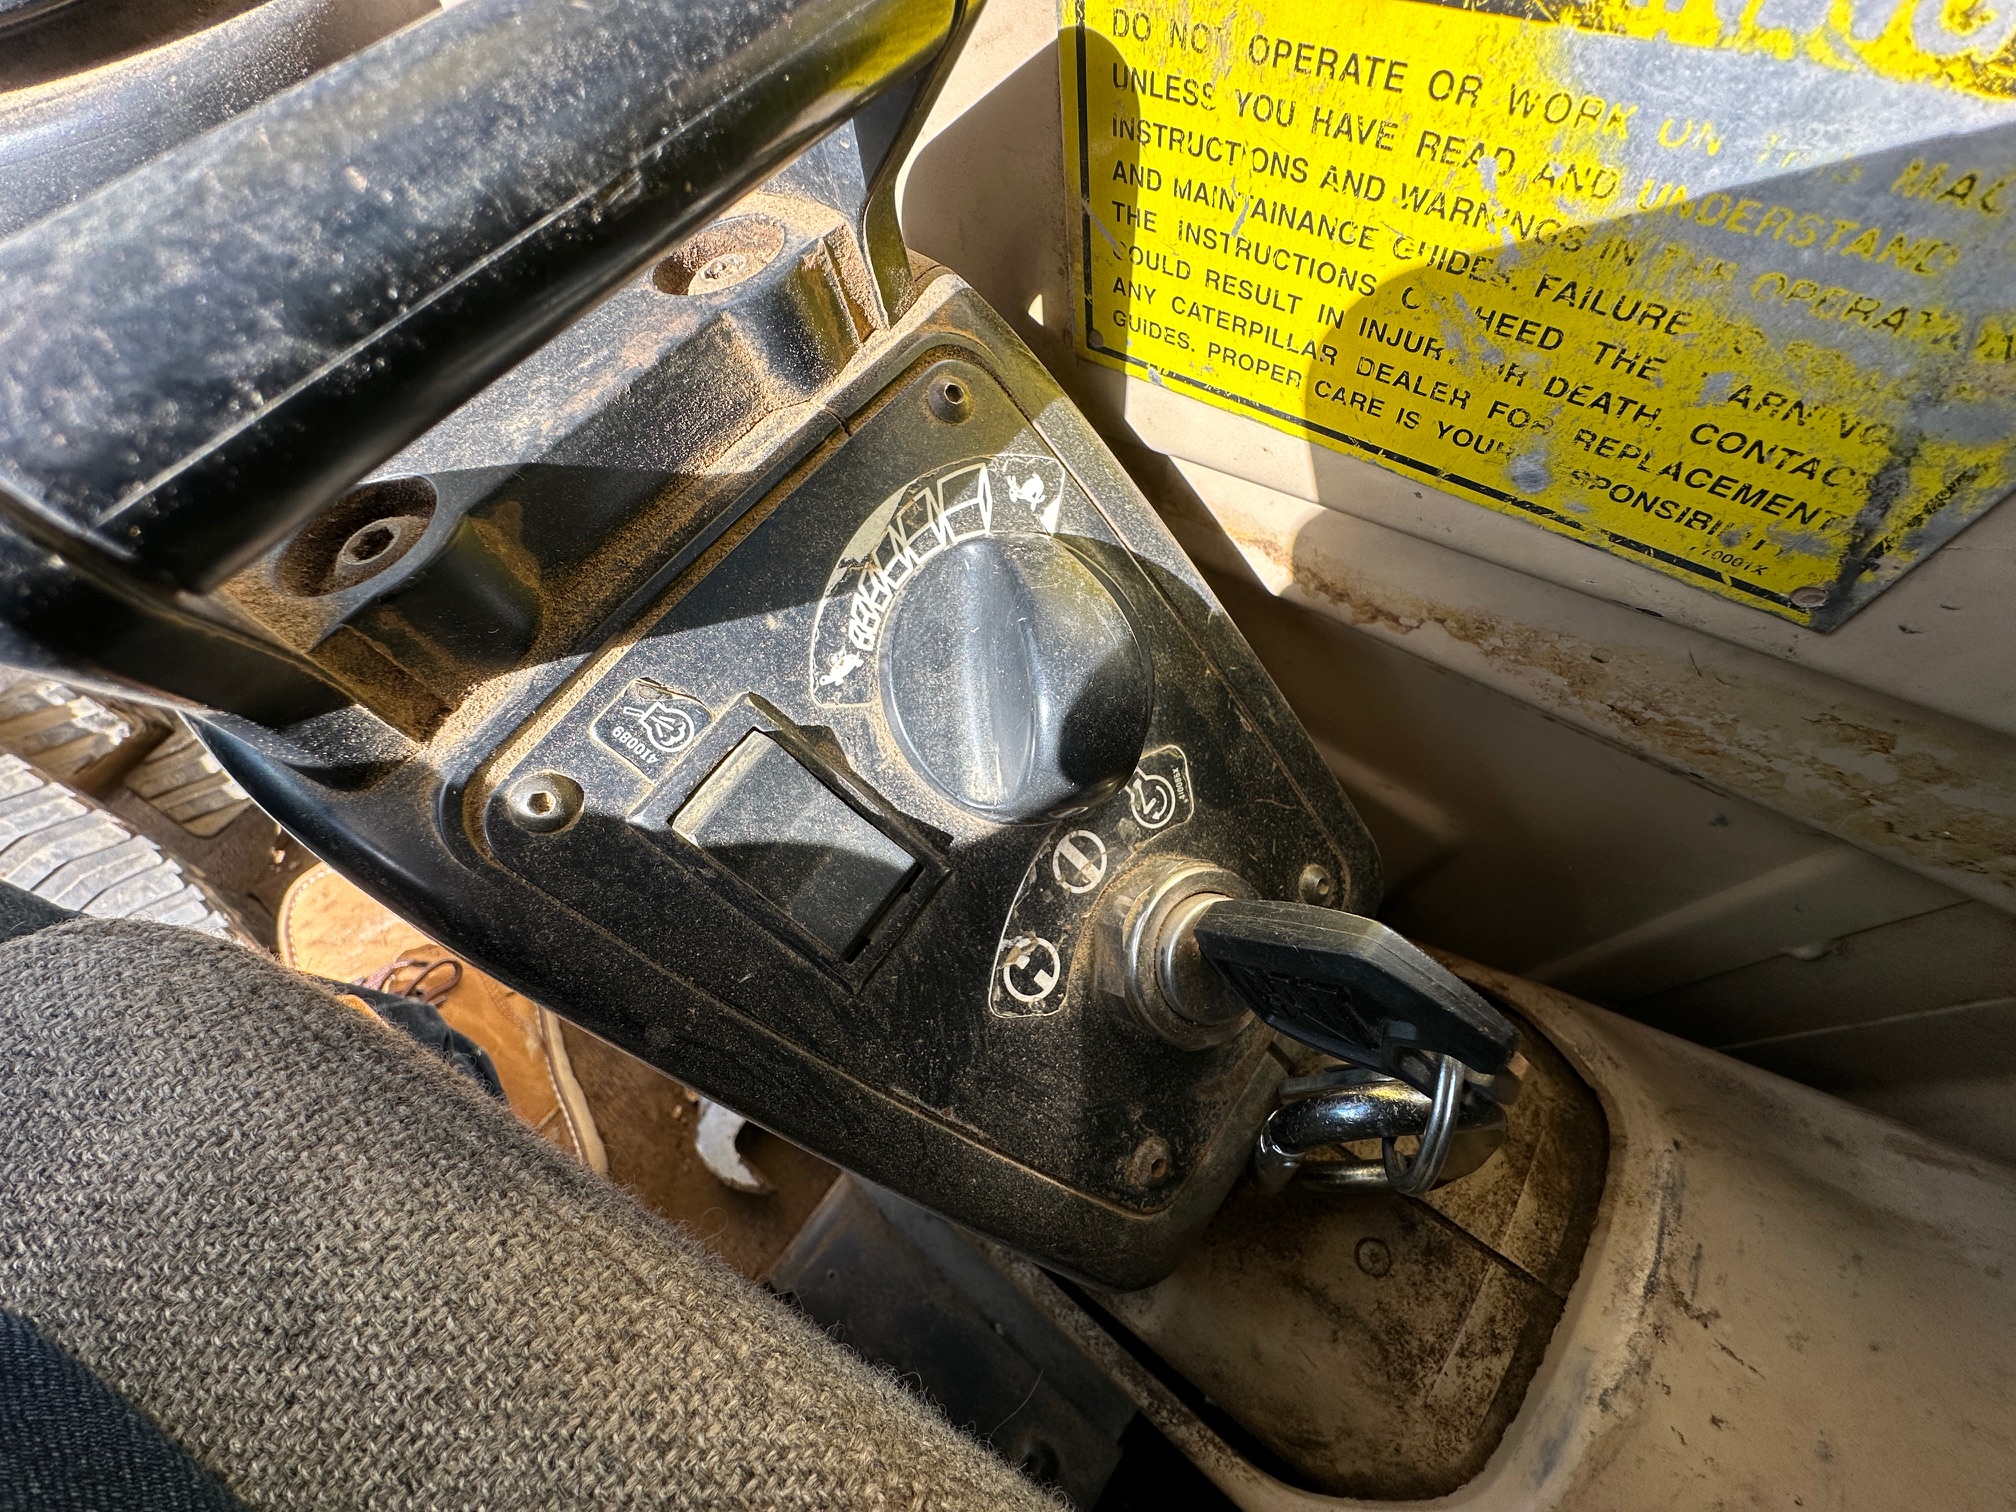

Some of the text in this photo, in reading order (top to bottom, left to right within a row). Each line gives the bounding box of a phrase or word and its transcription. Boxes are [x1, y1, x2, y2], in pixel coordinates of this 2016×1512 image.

[1113, 8, 1151, 42] DO
[1248, 34, 1408, 93] OPERATE
[1428, 69, 1483, 108] OR
[1508, 83, 1640, 140] WORK
[1112, 62, 1961, 278] UNLESS YOU HAVE READ AND UNDERSTAND
[1112, 114, 1309, 184] INSTRUCTONS
[1319, 165, 1386, 202] AND
[1400, 182, 1587, 253] WARNNGS
[1112, 160, 1162, 192] AND
[1534, 274, 1693, 336] FAILURE
[1112, 200, 1157, 233] THE
[1178, 220, 1378, 297] INSTRUCTIONS
[1475, 306, 1564, 351] HEED
[1594, 340, 1667, 381] THE
[1112, 309, 1196, 352] GUIDES.
[1208, 341, 1303, 390] PROPER
[1314, 379, 1385, 418] CARE
[1395, 407, 1422, 431] IS
[1205, 268, 1303, 314] RESULT
[1317, 303, 1345, 330] IN
[1358, 316, 1454, 365] INJUR
[1481, 362, 1529, 388] R
[1543, 375, 1662, 431] DEATH.
[1112, 276, 1157, 305] ANY
[1171, 296, 1339, 367] CATERPILLAR
[1356, 356, 1472, 410] DEALER
[1573, 428, 1848, 531] REPLACEMENT
